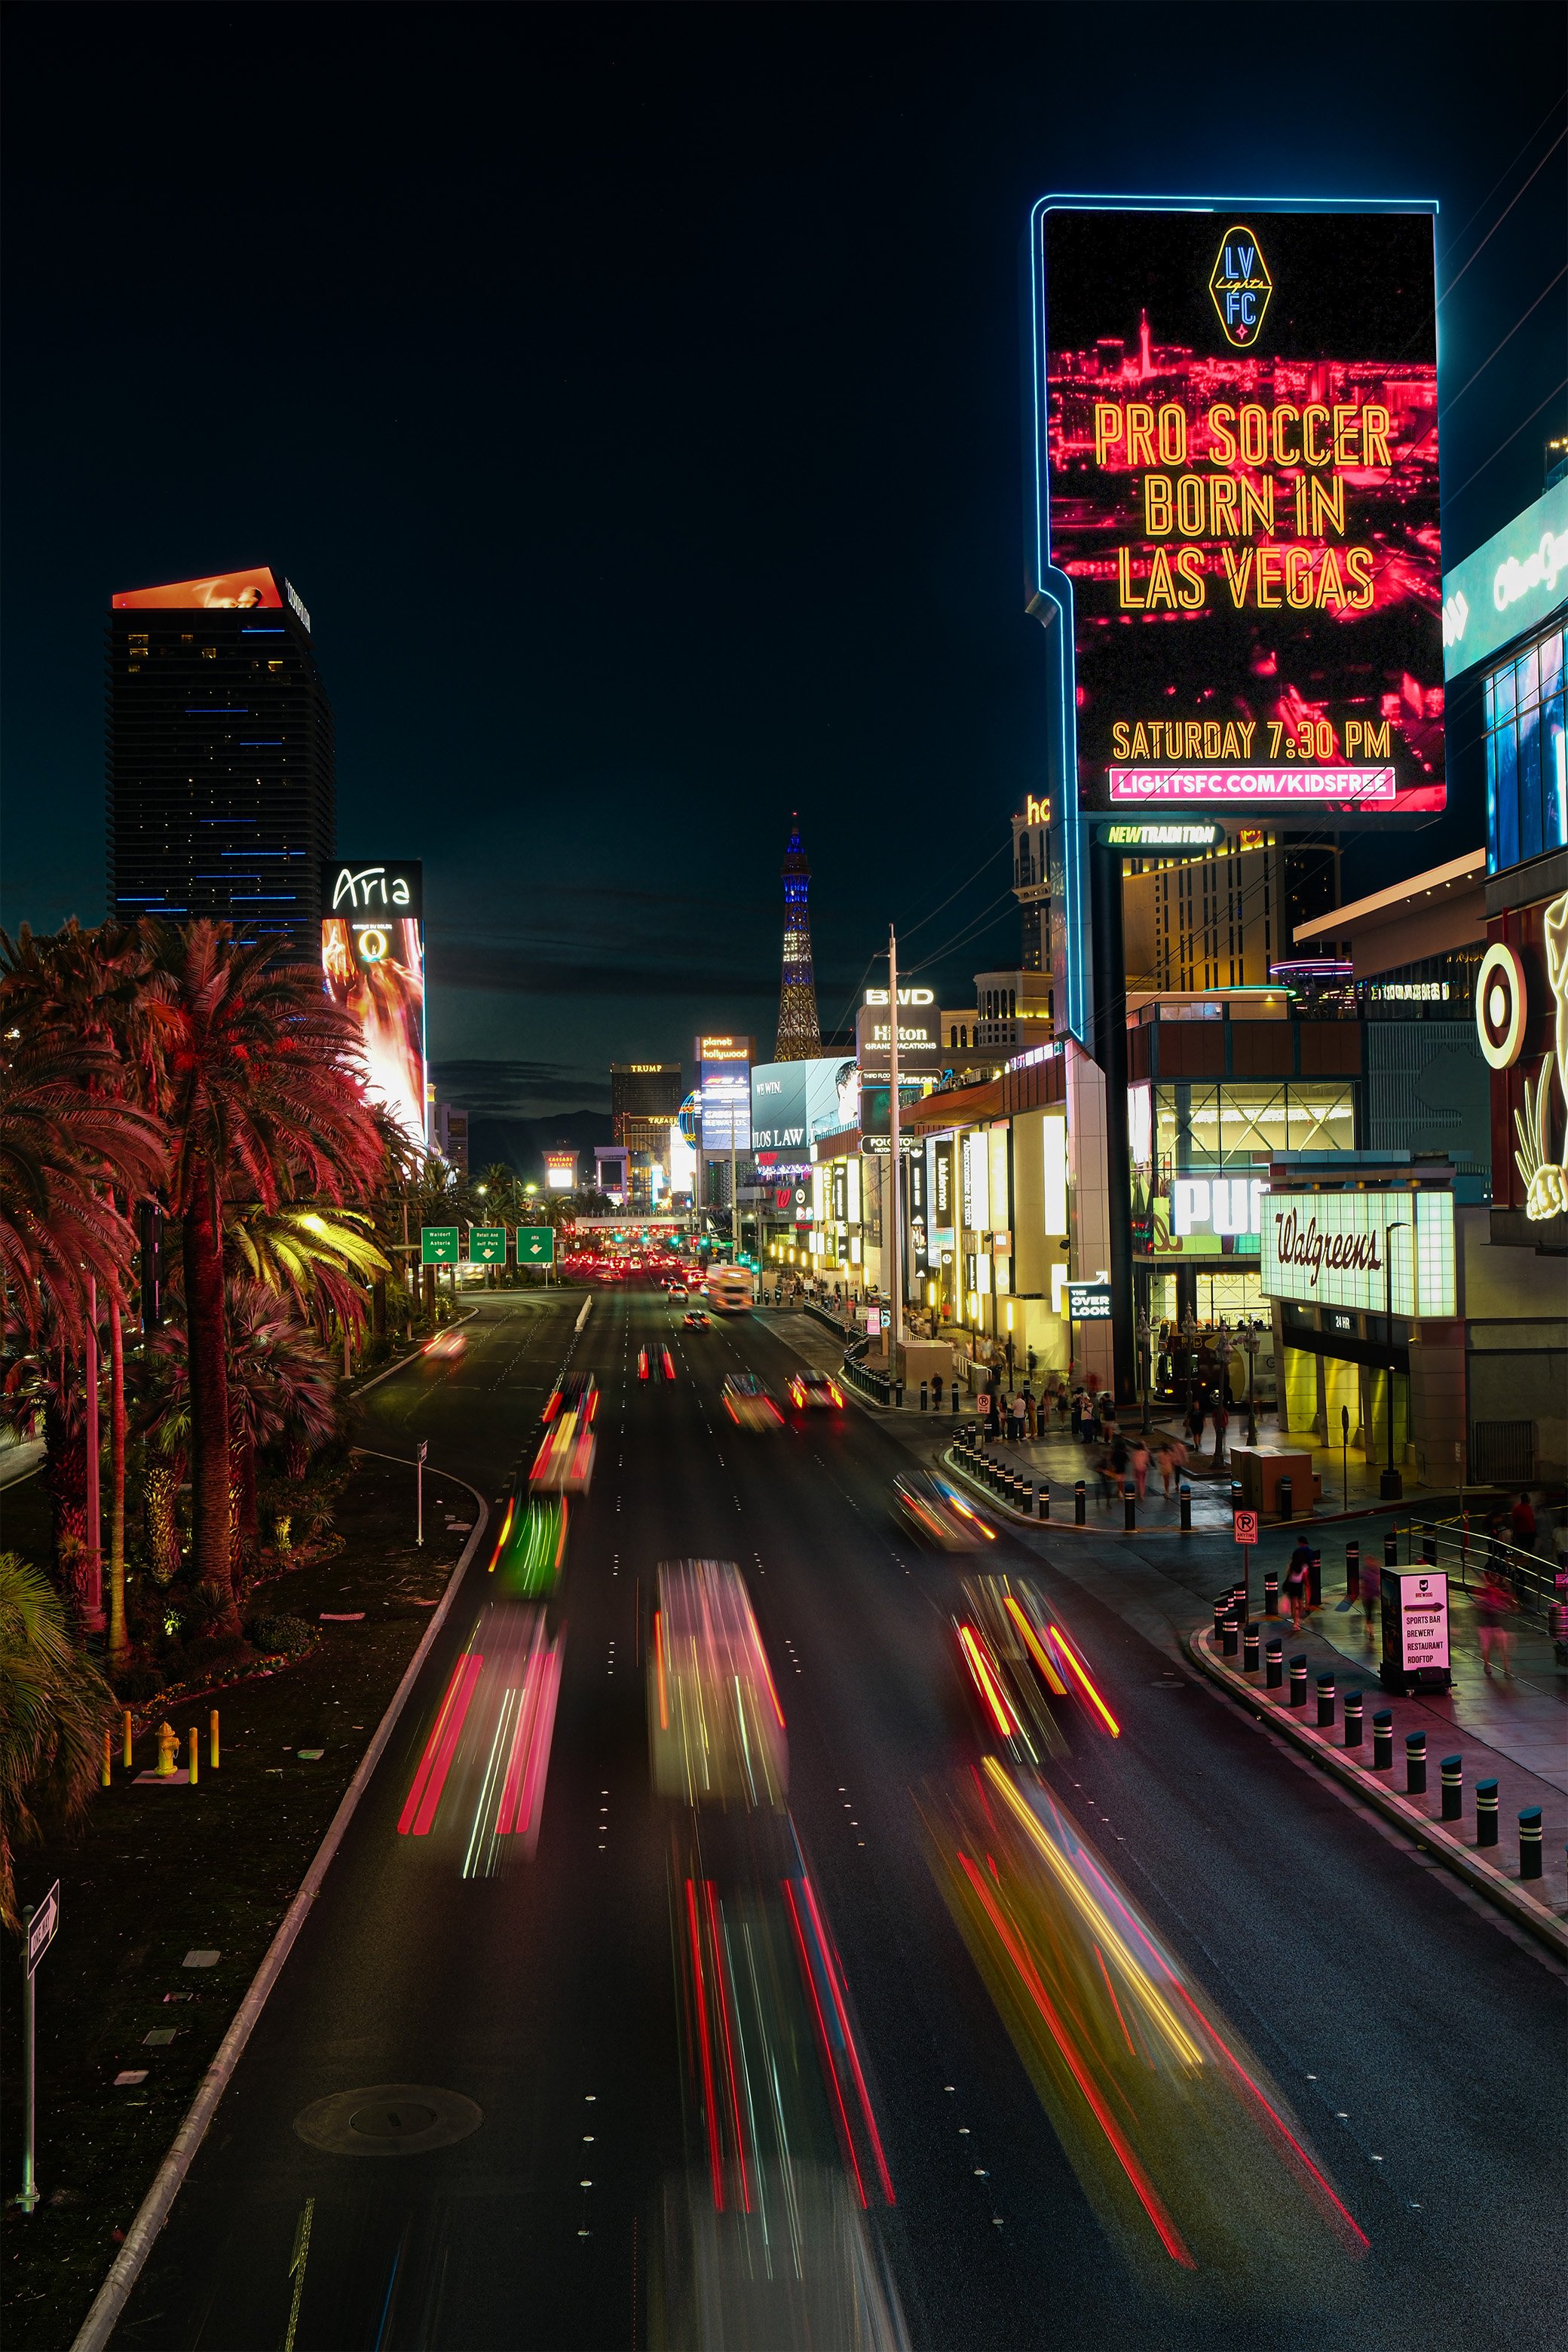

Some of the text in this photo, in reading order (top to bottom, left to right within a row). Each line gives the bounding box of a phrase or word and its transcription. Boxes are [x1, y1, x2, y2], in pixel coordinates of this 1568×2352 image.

[1225, 239, 1254, 279] LV
[1215, 276, 1269, 295] Lights
[1226, 292, 1257, 325] FC
[1095, 403, 1392, 467] PRO SOCCER
[1144, 474, 1346, 537] BORN IN
[1119, 547, 1374, 610] LAS VEGAS
[1112, 721, 1391, 760] SATURDAY 7:30 PM
[1119, 774, 1387, 793] LIGHTSFC.COM/KIDSFREE
[332, 868, 409, 909] Aria
[703, 1037, 733, 1048] planet
[874, 1025, 927, 1041] Hiton
[703, 1049, 748, 1060] hollywood
[756, 1084, 764, 1095] WE
[774, 1128, 804, 1147] LAW
[938, 1158, 949, 1211] lululemon
[1276, 1207, 1382, 1287] Walgreens
[1071, 1296, 1110, 1306] OVER
[1072, 1306, 1110, 1316] LOOK
[1335, 1315, 1350, 1330] 24 HR
[1406, 1615, 1441, 1625] SPORTS BAR
[1407, 1629, 1435, 1638] BREWERY
[1407, 1641, 1444, 1651] RESTAURANT
[1407, 1655, 1434, 1664] ROOFTOP
[32, 1924, 42, 1951] ONE
